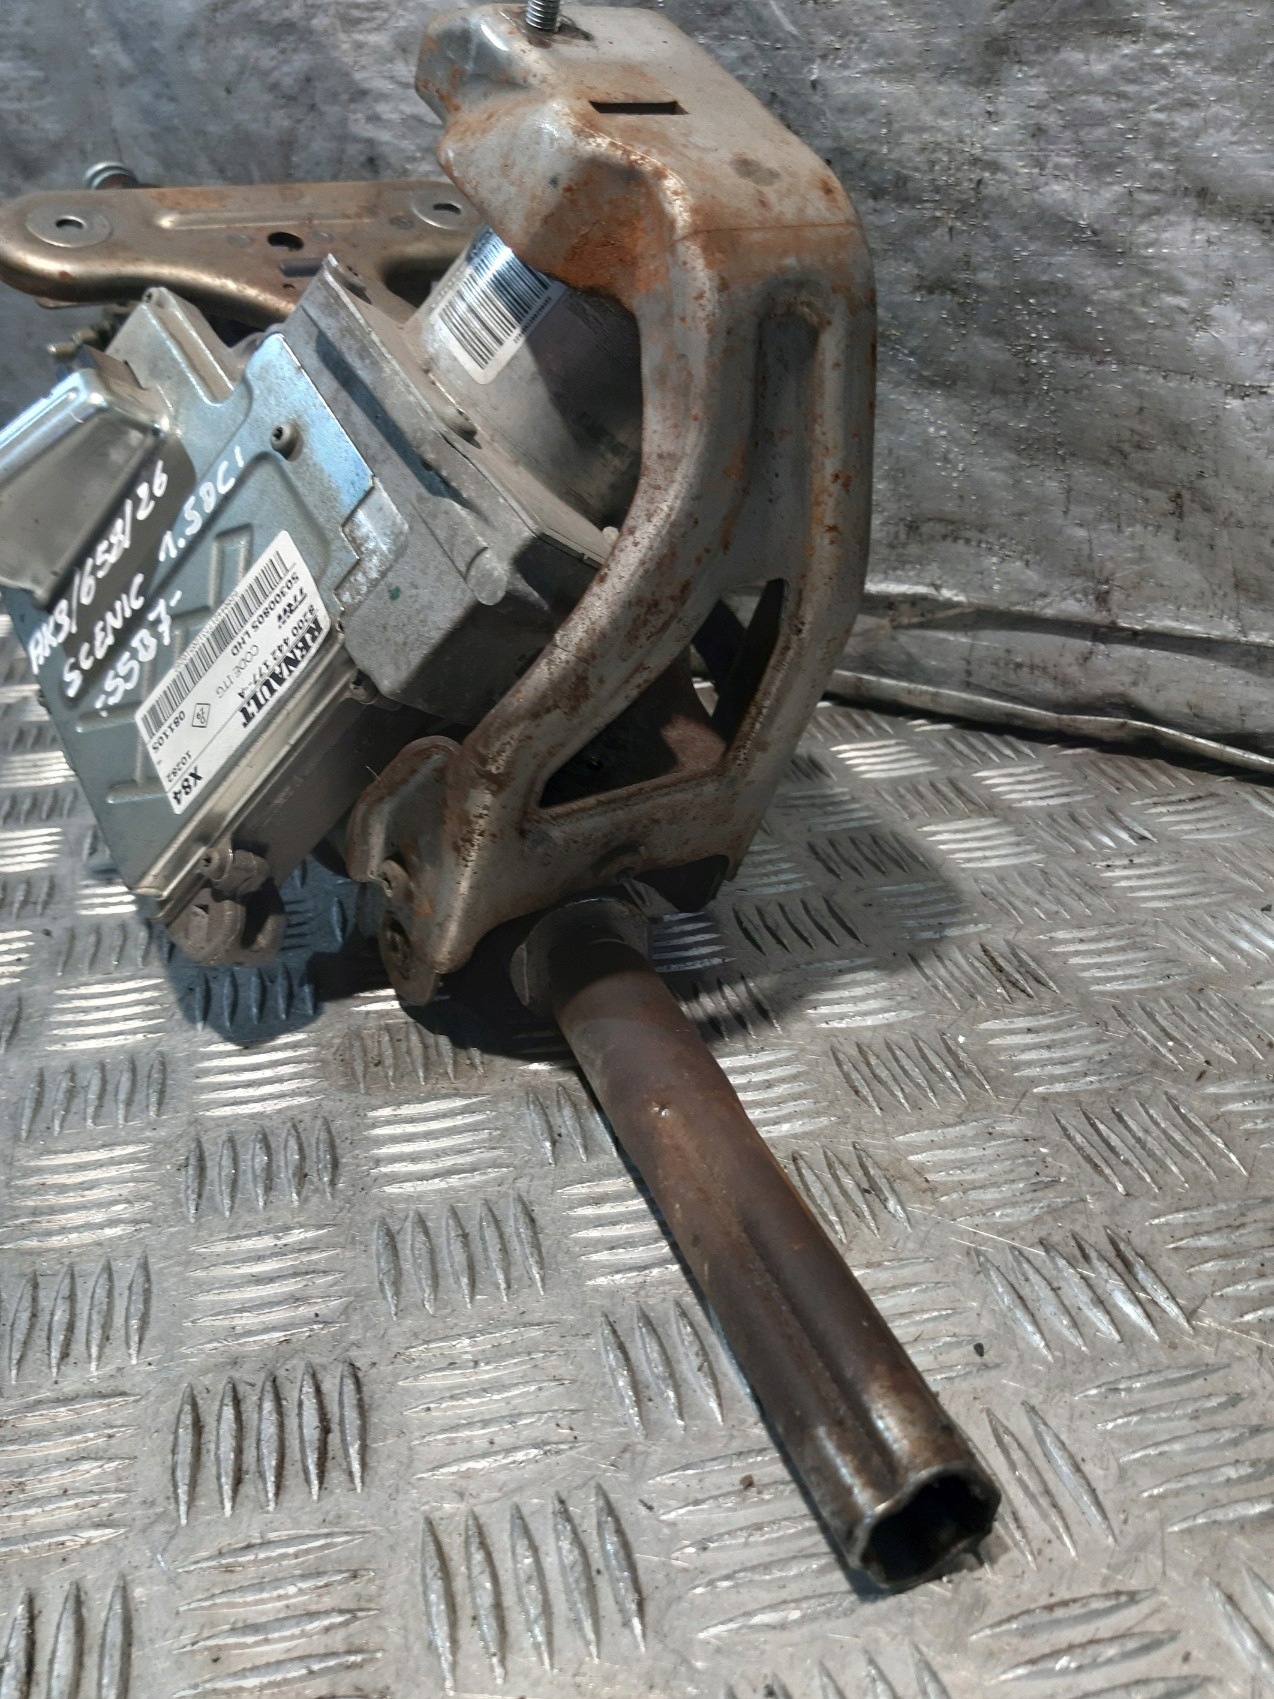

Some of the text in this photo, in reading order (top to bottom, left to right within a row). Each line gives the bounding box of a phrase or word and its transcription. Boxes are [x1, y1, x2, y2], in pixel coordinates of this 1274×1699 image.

[276, 586, 308, 629] TRW
[290, 604, 316, 637] 8200
[63, 573, 145, 698] SCENIC
[231, 631, 251, 657] LHD
[270, 637, 291, 662] 442
[231, 644, 259, 677] CODE
[240, 614, 324, 728] RENAULT
[173, 765, 203, 805] X84
